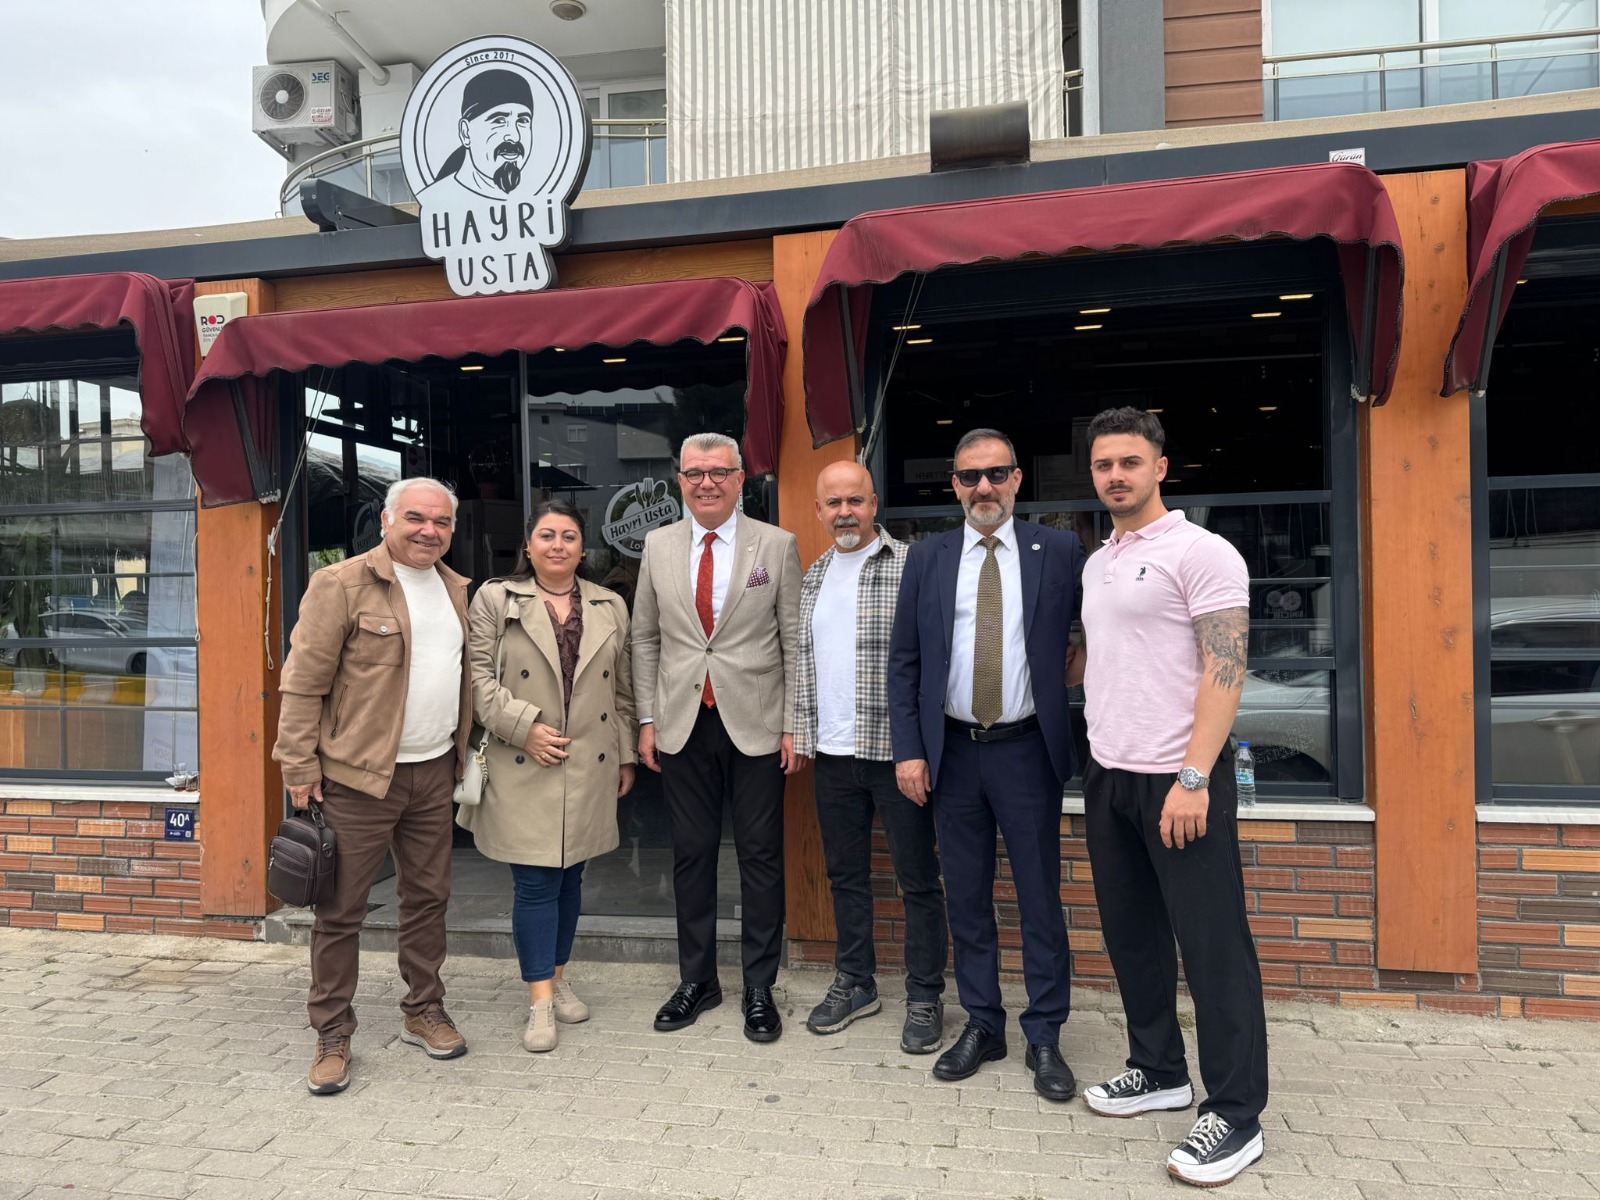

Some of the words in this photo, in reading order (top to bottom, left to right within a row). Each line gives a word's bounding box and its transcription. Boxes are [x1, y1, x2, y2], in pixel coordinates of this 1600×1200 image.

[464, 53, 490, 66] Since
[493, 51, 515, 62] 2011
[457, 252, 540, 287] USTA
[610, 515, 642, 539] Hayri
[645, 504, 673, 523] Usta
